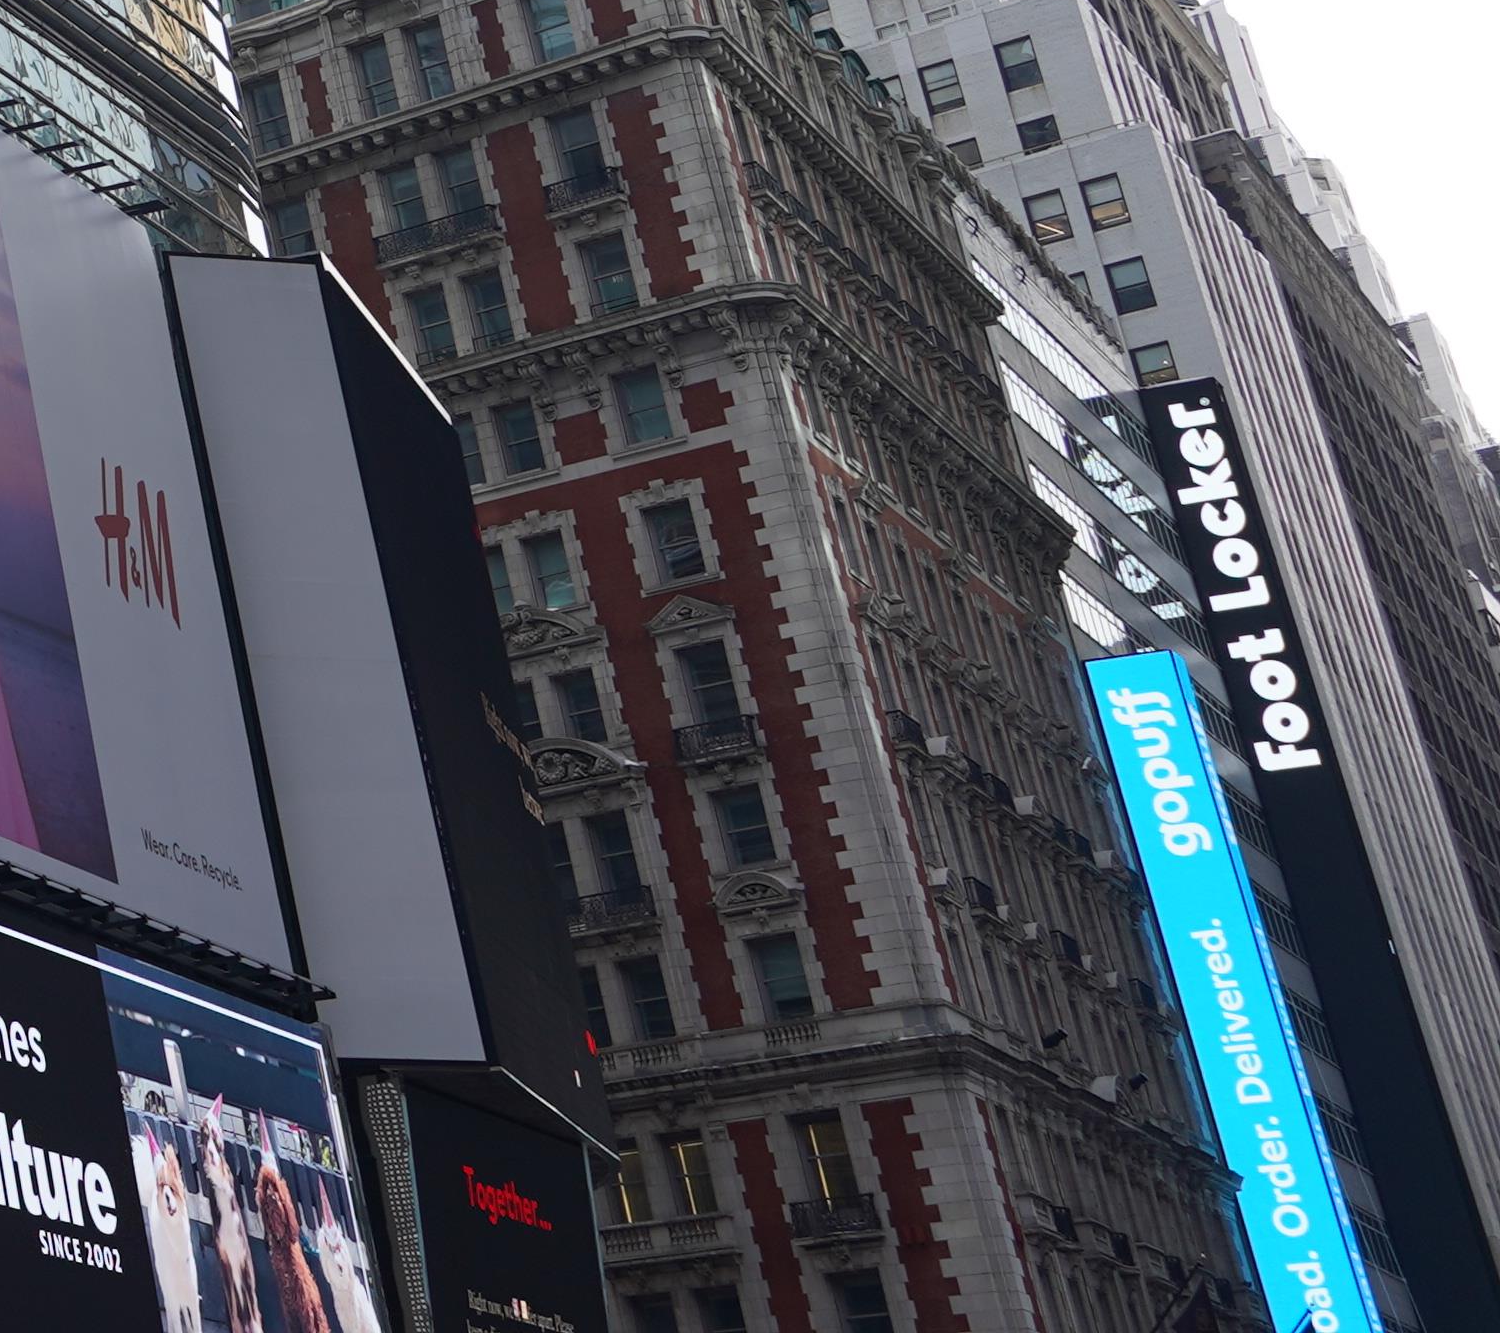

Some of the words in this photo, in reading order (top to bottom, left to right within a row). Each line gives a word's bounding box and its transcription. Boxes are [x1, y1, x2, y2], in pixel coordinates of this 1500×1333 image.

[94, 456, 182, 632] H&M
[1167, 402, 1272, 613] Locker
[1107, 687, 1213, 857] gopuff
[1226, 627, 1322, 773] Foot
[140, 826, 173, 861] Wear.
[173, 842, 202, 874] Care.
[201, 854, 244, 892] Recycle.
[1190, 917, 1274, 1106] Delivered.
[461, 1164, 553, 1232] Together...
[1254, 1115, 1311, 1238] Order.
[39, 1229, 83, 1265] SINCE
[84, 1241, 124, 1274] 2002
